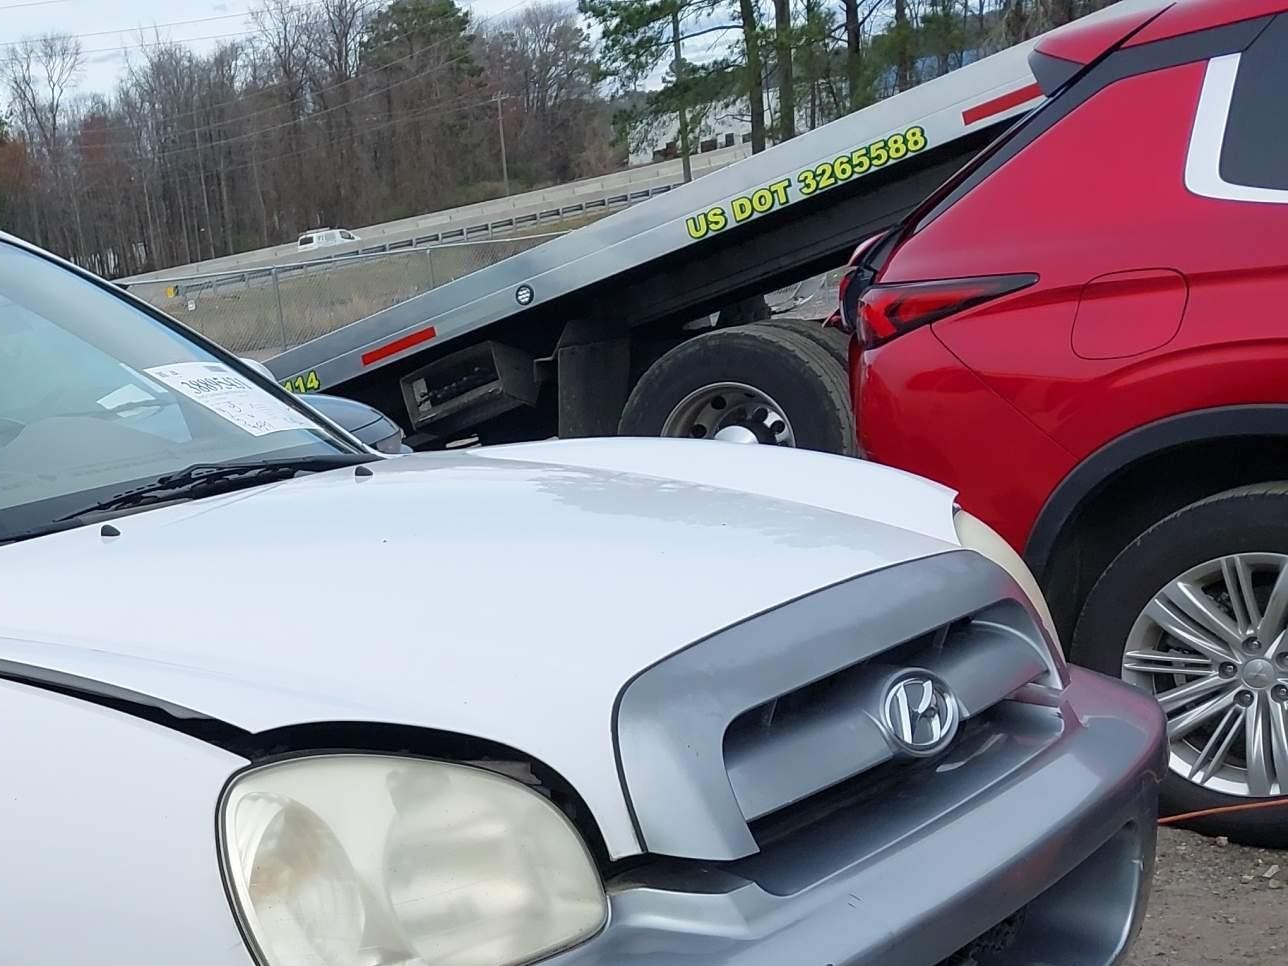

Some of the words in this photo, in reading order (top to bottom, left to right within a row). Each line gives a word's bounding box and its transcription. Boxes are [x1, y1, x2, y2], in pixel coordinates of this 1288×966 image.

[687, 208, 727, 239] US
[732, 178, 792, 222] DOT
[798, 126, 927, 195] 3265588
